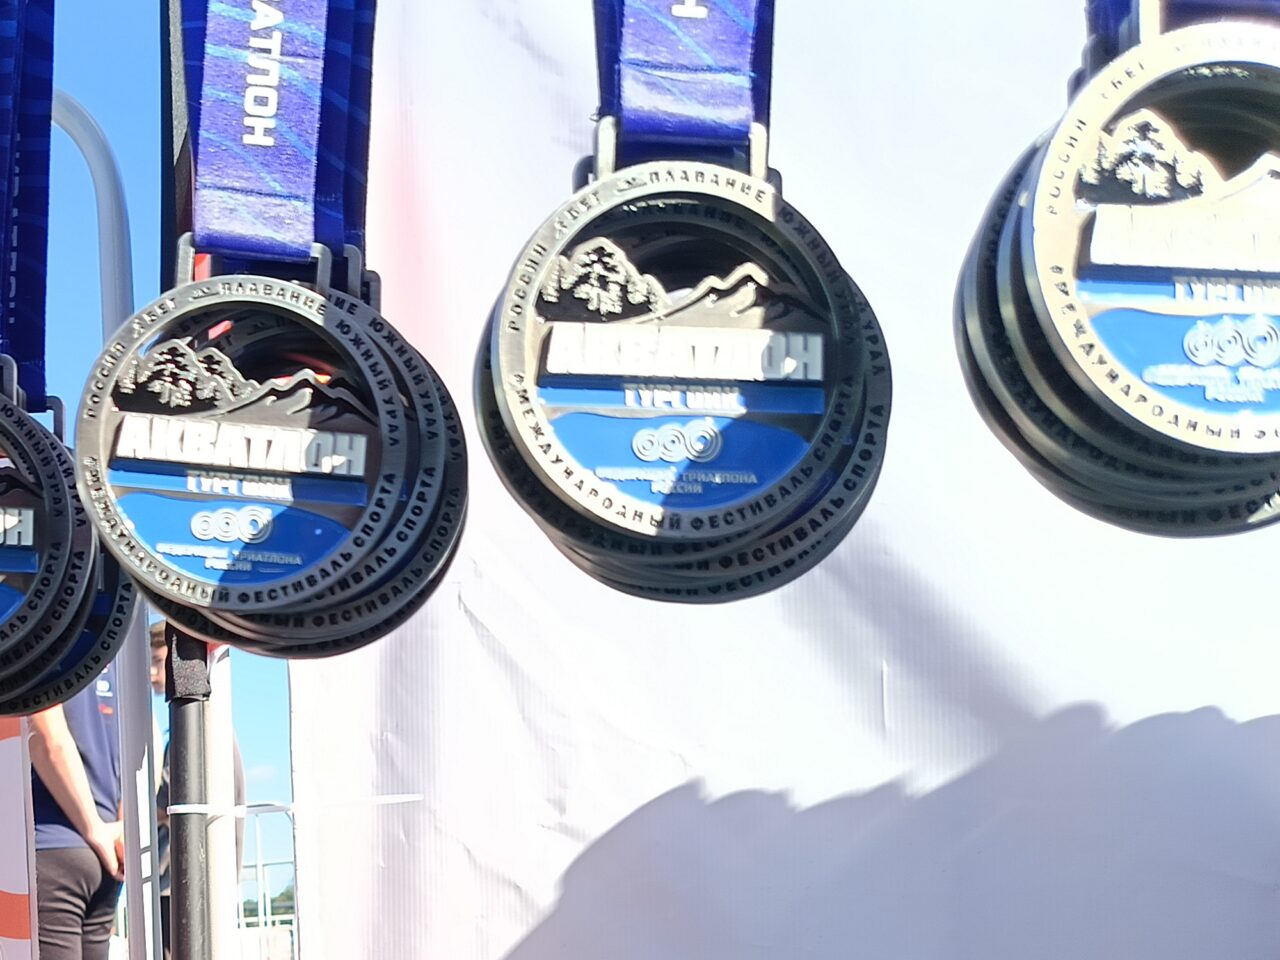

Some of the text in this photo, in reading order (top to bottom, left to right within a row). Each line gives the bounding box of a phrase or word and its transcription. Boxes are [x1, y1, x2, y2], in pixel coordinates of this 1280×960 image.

[243, 0, 284, 147] АТЛОН
[775, 205, 840, 284] ЮЖНЫЙ
[334, 317, 391, 391] ЮЖНЫЙ
[381, 394, 400, 446] УРАЛ
[368, 317, 438, 441] ЮЖНЫЙ УРАЛ
[863, 321, 884, 376] УРАЛ
[117, 416, 368, 477] АКВАТЛОН
[443, 410, 462, 462] УРАЛ
[45, 470, 64, 517] УРАЛ
[396, 465, 435, 543] СПОРТА
[689, 459, 815, 530] ФЕСТИВАЛЬ
[717, 402, 886, 571] ФЕСТИВАЛЬ СПОРТА
[25, 540, 63, 612] СПОРТА
[237, 547, 354, 603] ФЕСТИВАЛЬ
[350, 471, 395, 549] СПОРТА
[310, 565, 424, 626] ФЕСТИВАЛЬ
[421, 486, 460, 563] СПОРТА
[51, 549, 83, 622] СПОРТА
[8, 652, 102, 712] ФЕСТИВАЛЬ
[100, 582, 133, 652] СПОРТА
